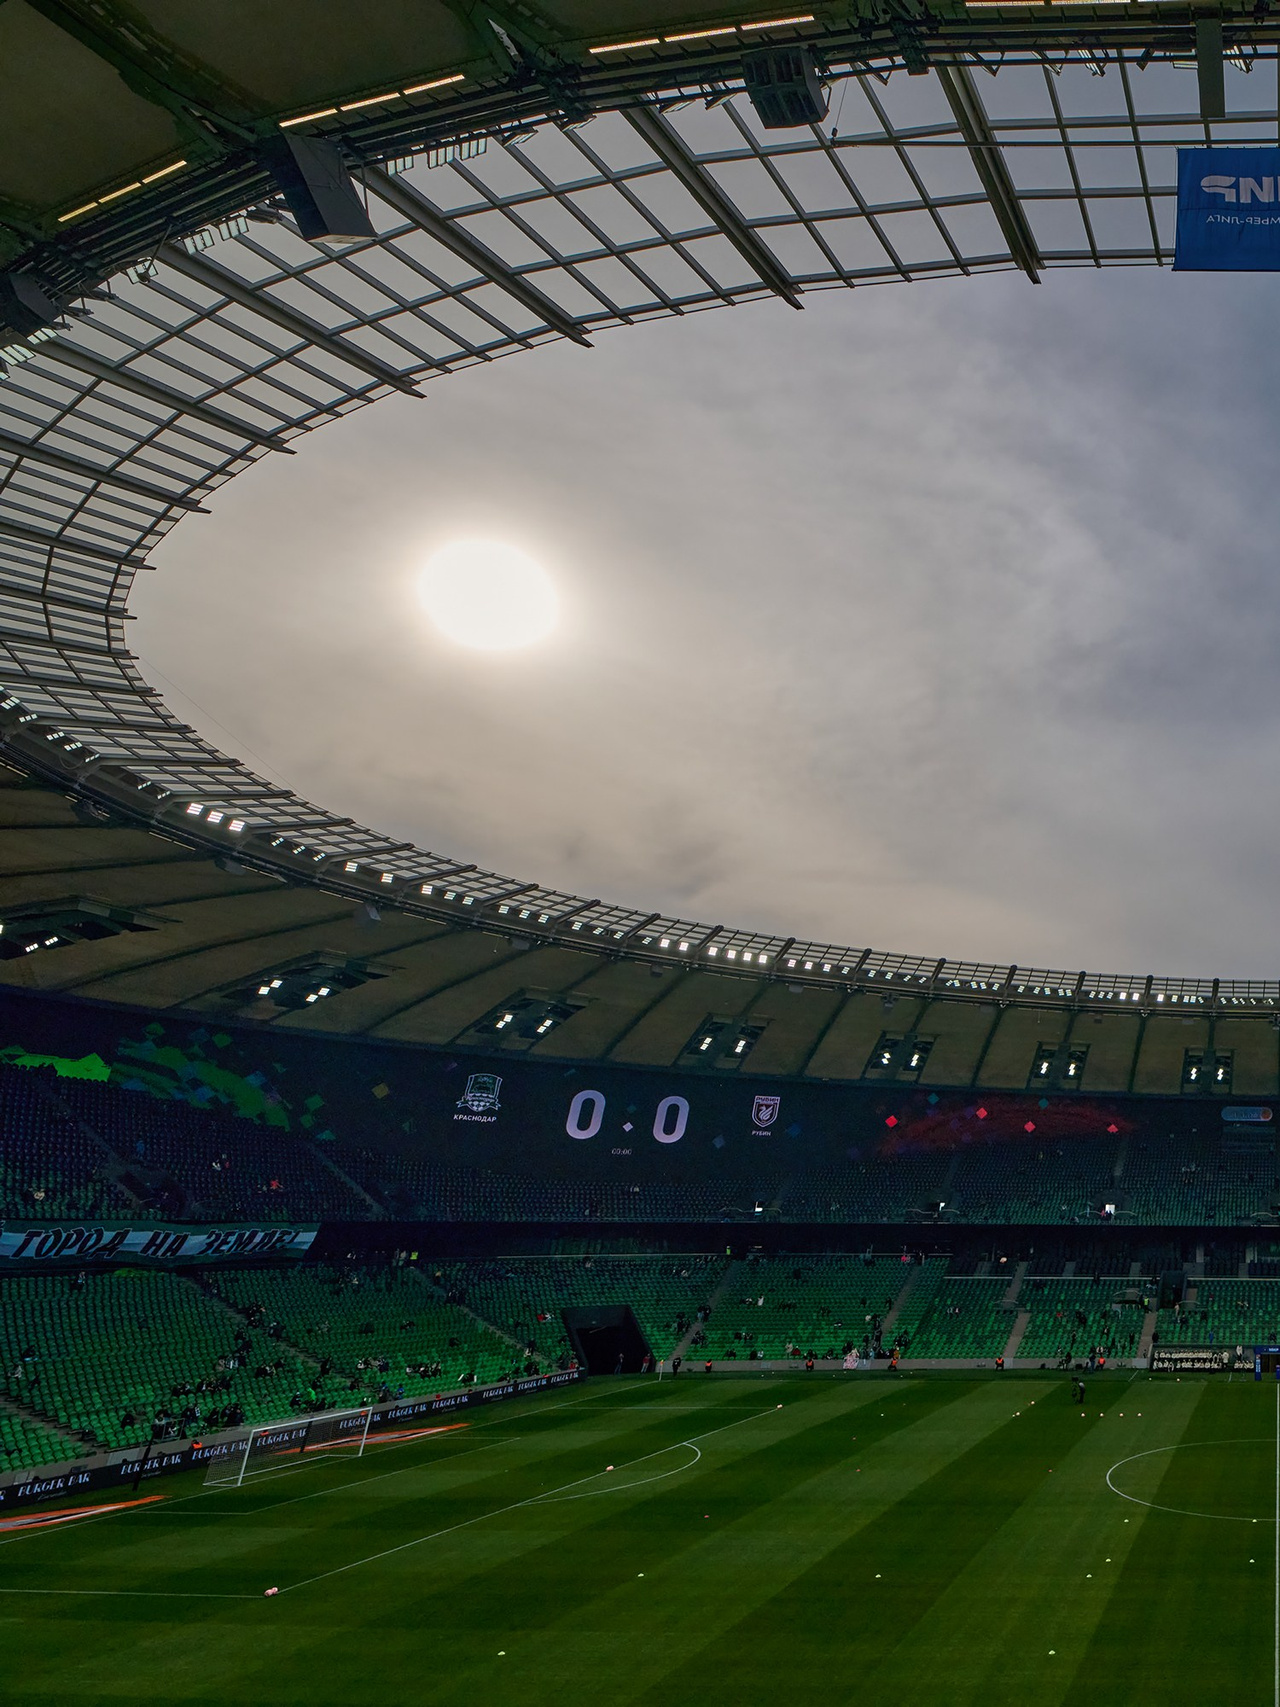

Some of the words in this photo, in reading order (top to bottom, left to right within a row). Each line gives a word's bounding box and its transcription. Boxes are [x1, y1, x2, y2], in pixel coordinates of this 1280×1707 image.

[453, 1114, 498, 1123] КРАСНОДАР
[566, 1089, 606, 1140] 0
[652, 1095, 690, 1144] 0
[138, 1229, 191, 1258] НА
[17, 1476, 66, 1497] BURGER
[67, 1472, 91, 1487] BAR
